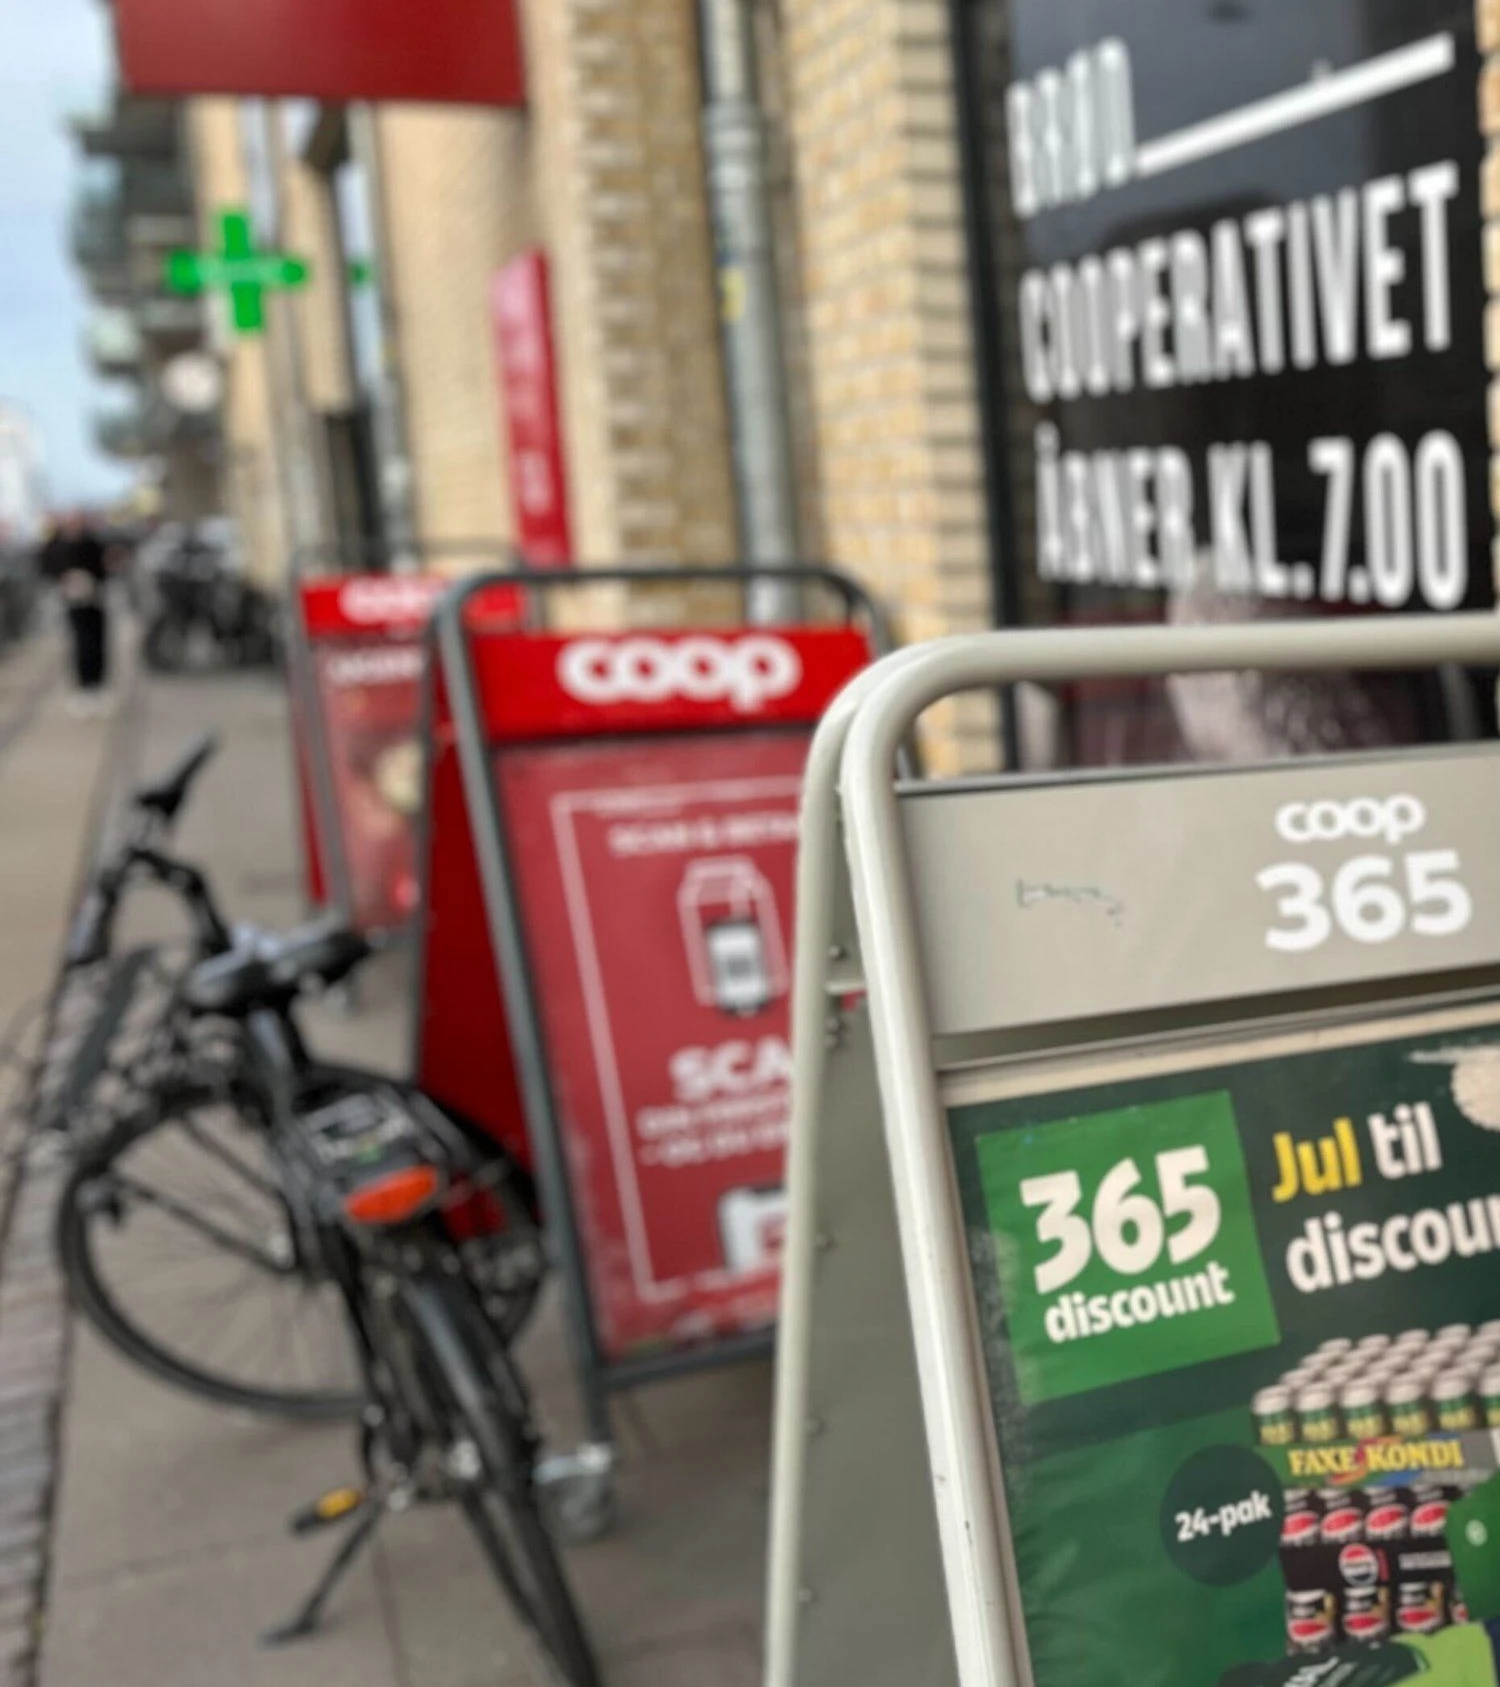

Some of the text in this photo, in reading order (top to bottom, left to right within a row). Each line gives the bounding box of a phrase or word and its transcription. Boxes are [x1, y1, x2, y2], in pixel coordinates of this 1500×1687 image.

[1019, 159, 1458, 402] COOPERATIVET
[1033, 420, 1469, 609] ÅBNER KL. 7.00
[556, 634, 801, 710] coop
[1274, 793, 1426, 844] coop
[1255, 848, 1474, 951] 365
[1270, 1102, 1443, 1203] Jul til
[1019, 1145, 1223, 1295] 365
[1044, 1260, 1236, 1343] discount
[1288, 1438, 1465, 1477] FAXE KONDI
[1175, 1490, 1273, 1543] 24-pak
